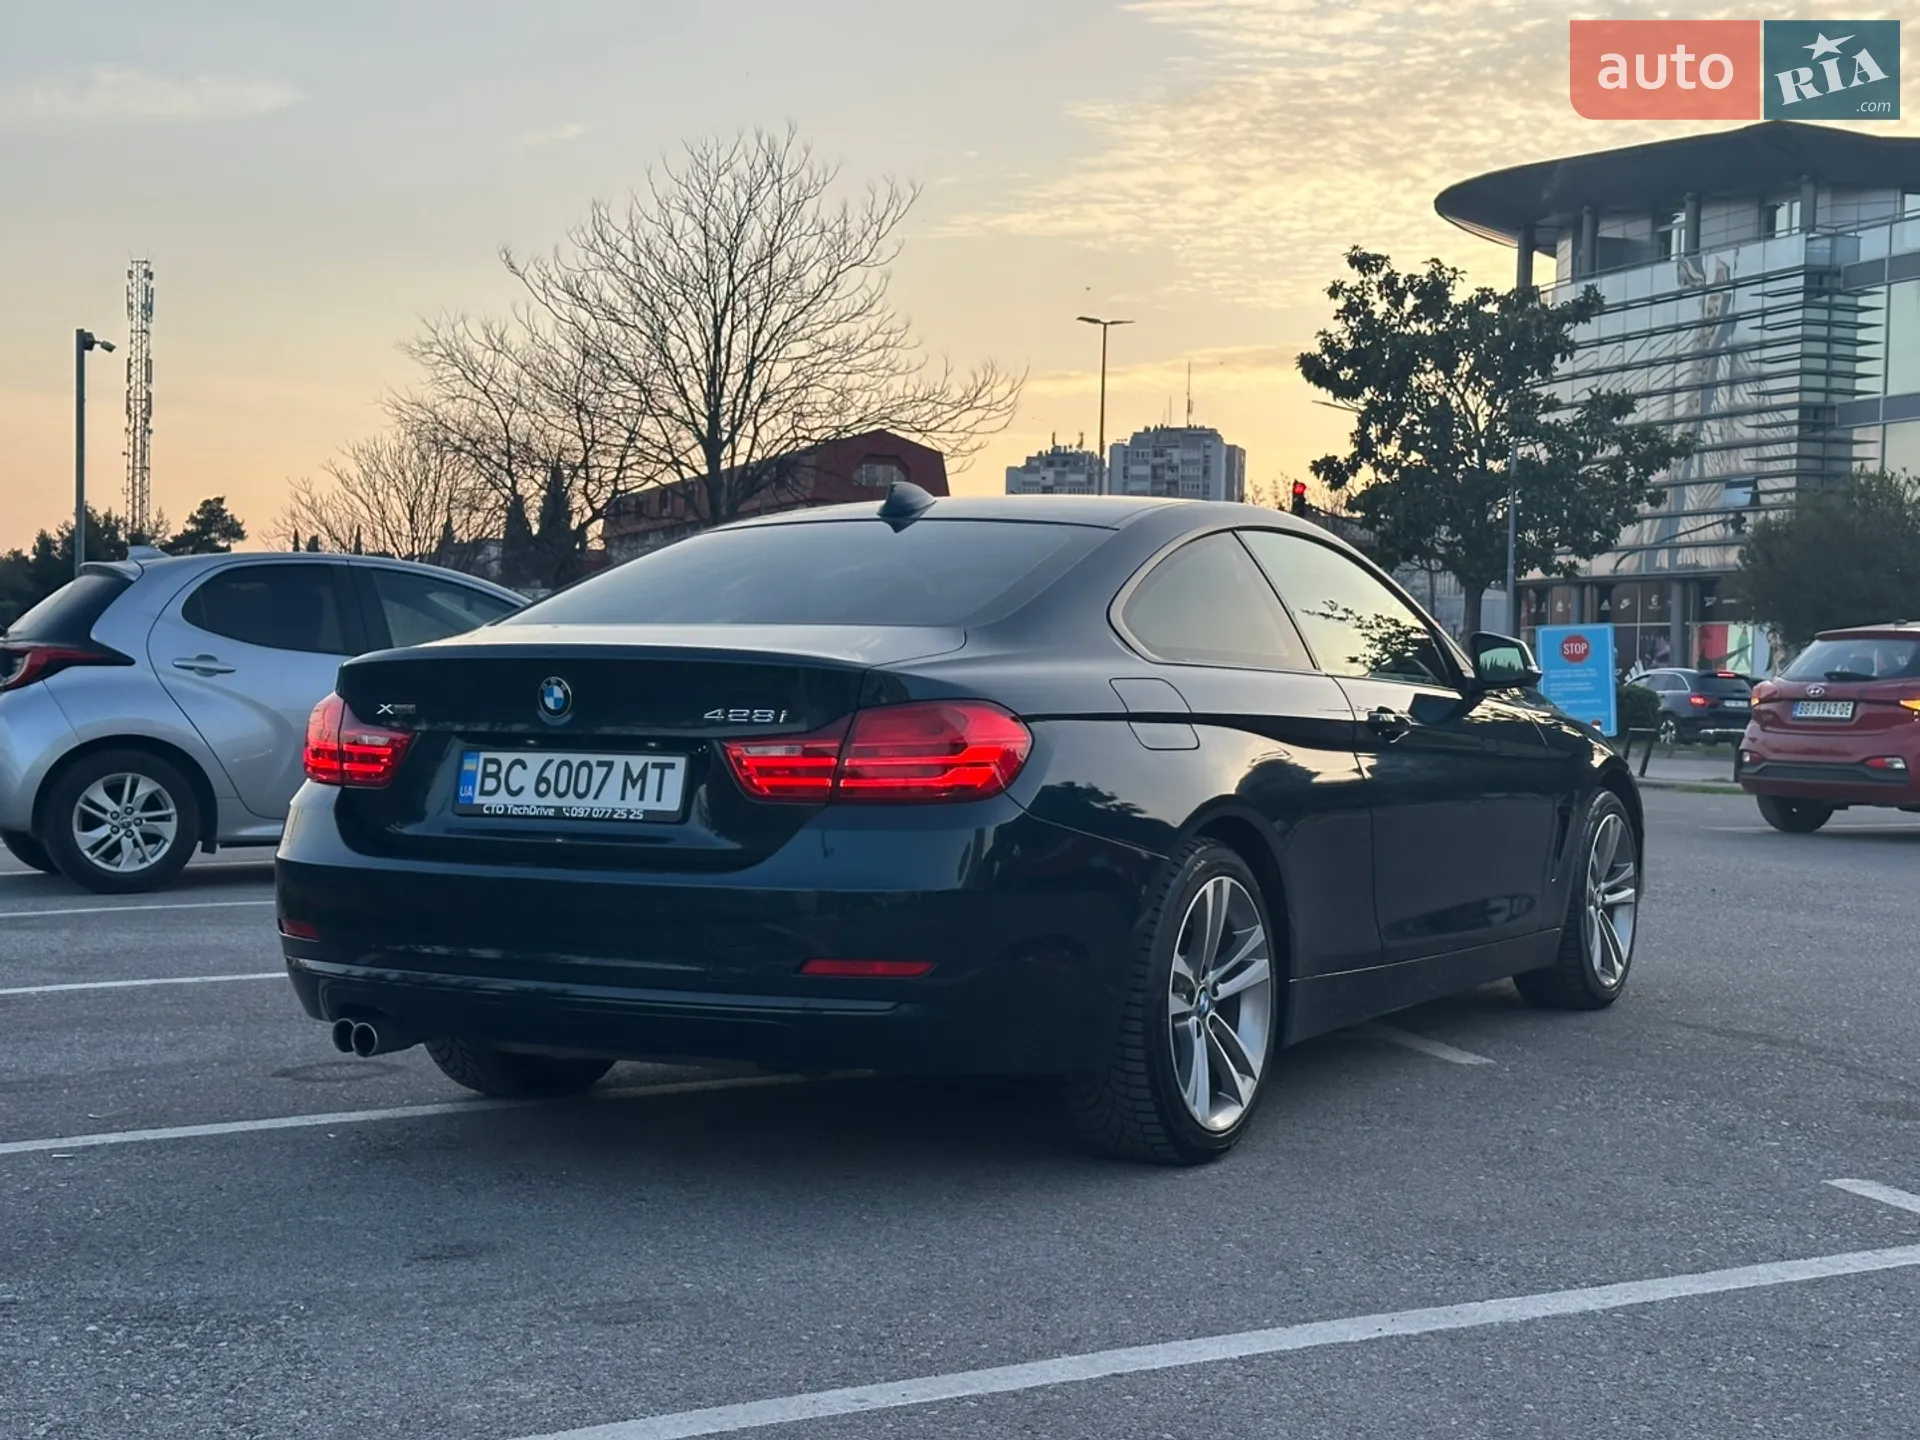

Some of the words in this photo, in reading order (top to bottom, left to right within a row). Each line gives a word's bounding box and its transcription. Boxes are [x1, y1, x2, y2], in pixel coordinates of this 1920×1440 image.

[1563, 643, 1588, 655] STOP
[703, 708, 789, 724] 428i
[478, 757, 528, 797] BC
[534, 758, 615, 800] 6007
[620, 760, 676, 802] MT
[459, 785, 473, 797] UA
[507, 804, 555, 816] TechDrive
[571, 808, 591, 818] 097
[592, 808, 612, 819] 077
[613, 809, 627, 819] 25
[629, 809, 644, 820] 25
